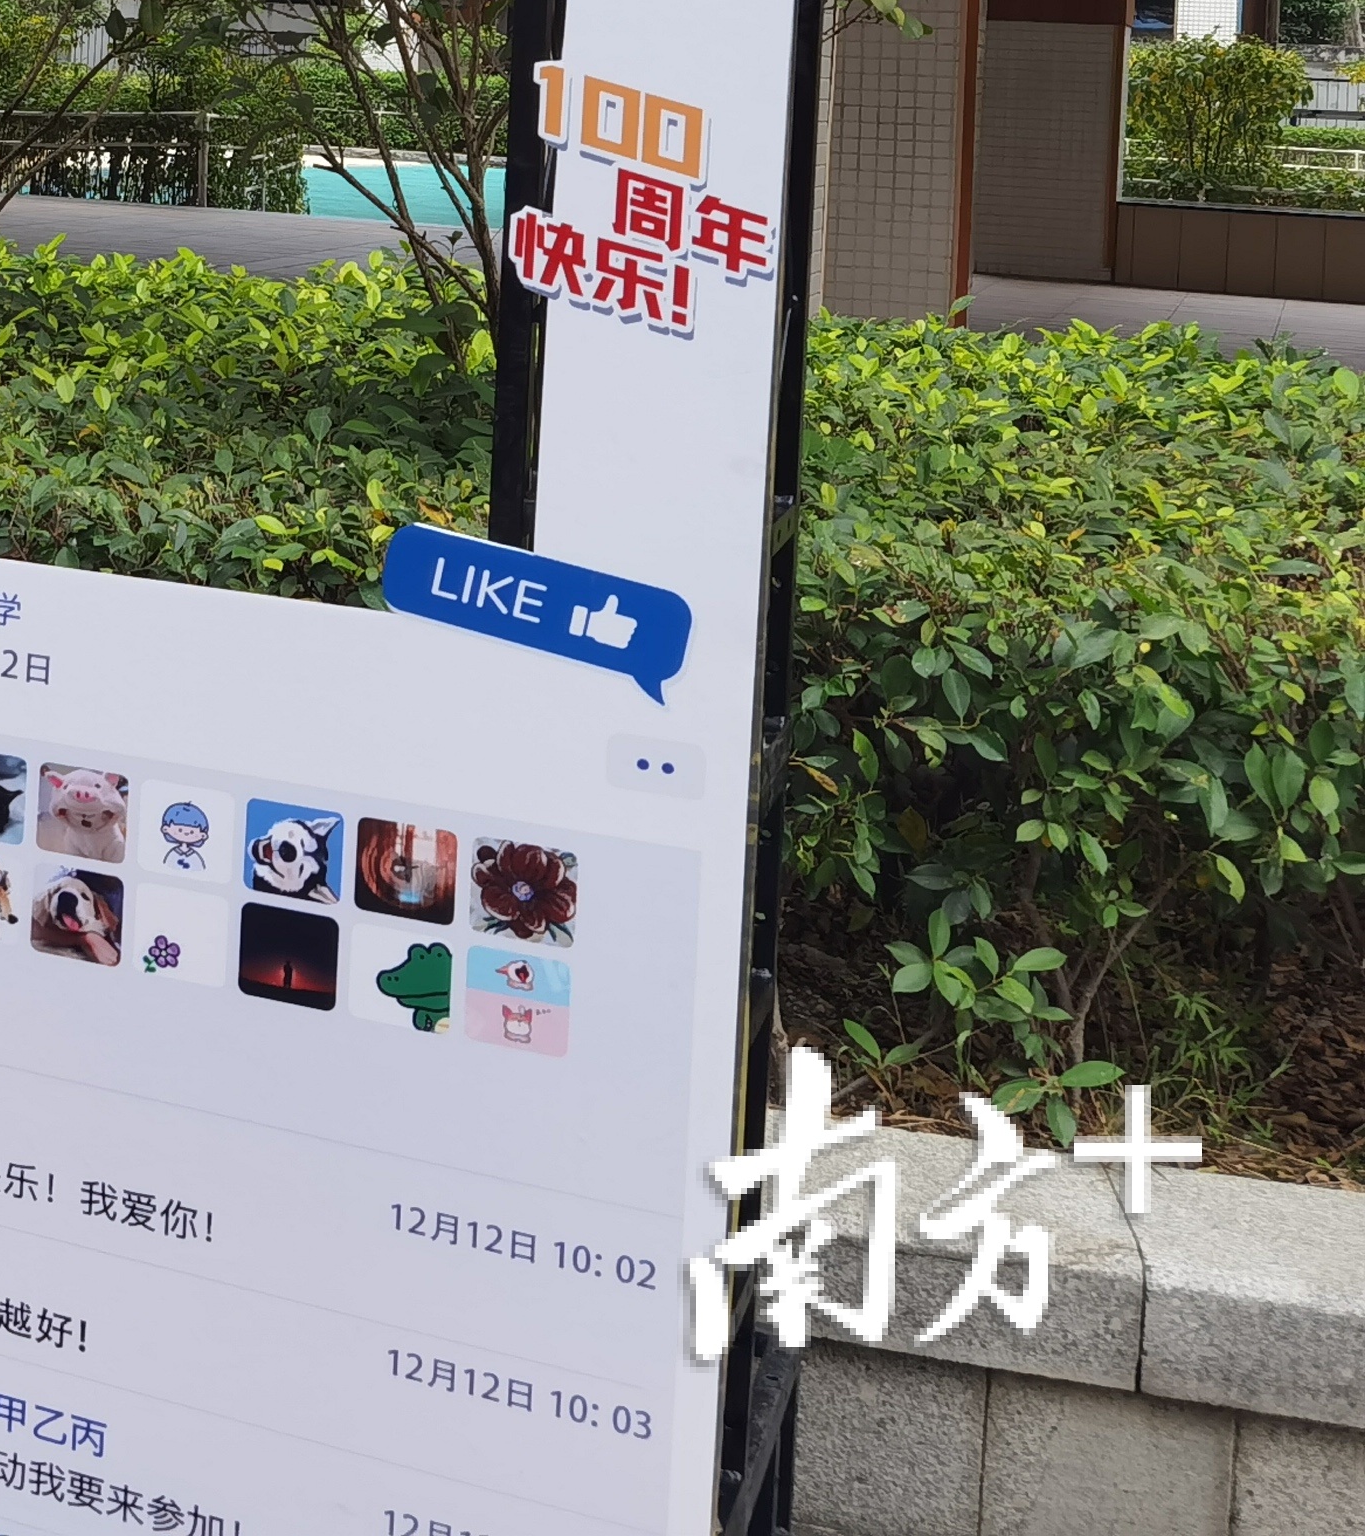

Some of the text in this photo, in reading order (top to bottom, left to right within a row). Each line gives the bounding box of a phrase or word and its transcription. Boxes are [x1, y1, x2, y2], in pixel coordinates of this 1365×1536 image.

[539, 65, 703, 179] 100
[611, 168, 768, 273] 周年
[514, 211, 690, 326] 快乐!
[430, 556, 548, 624] LIKE
[390, 1203, 538, 1265] 12月12日
[387, 1348, 535, 1413] 12月12日
